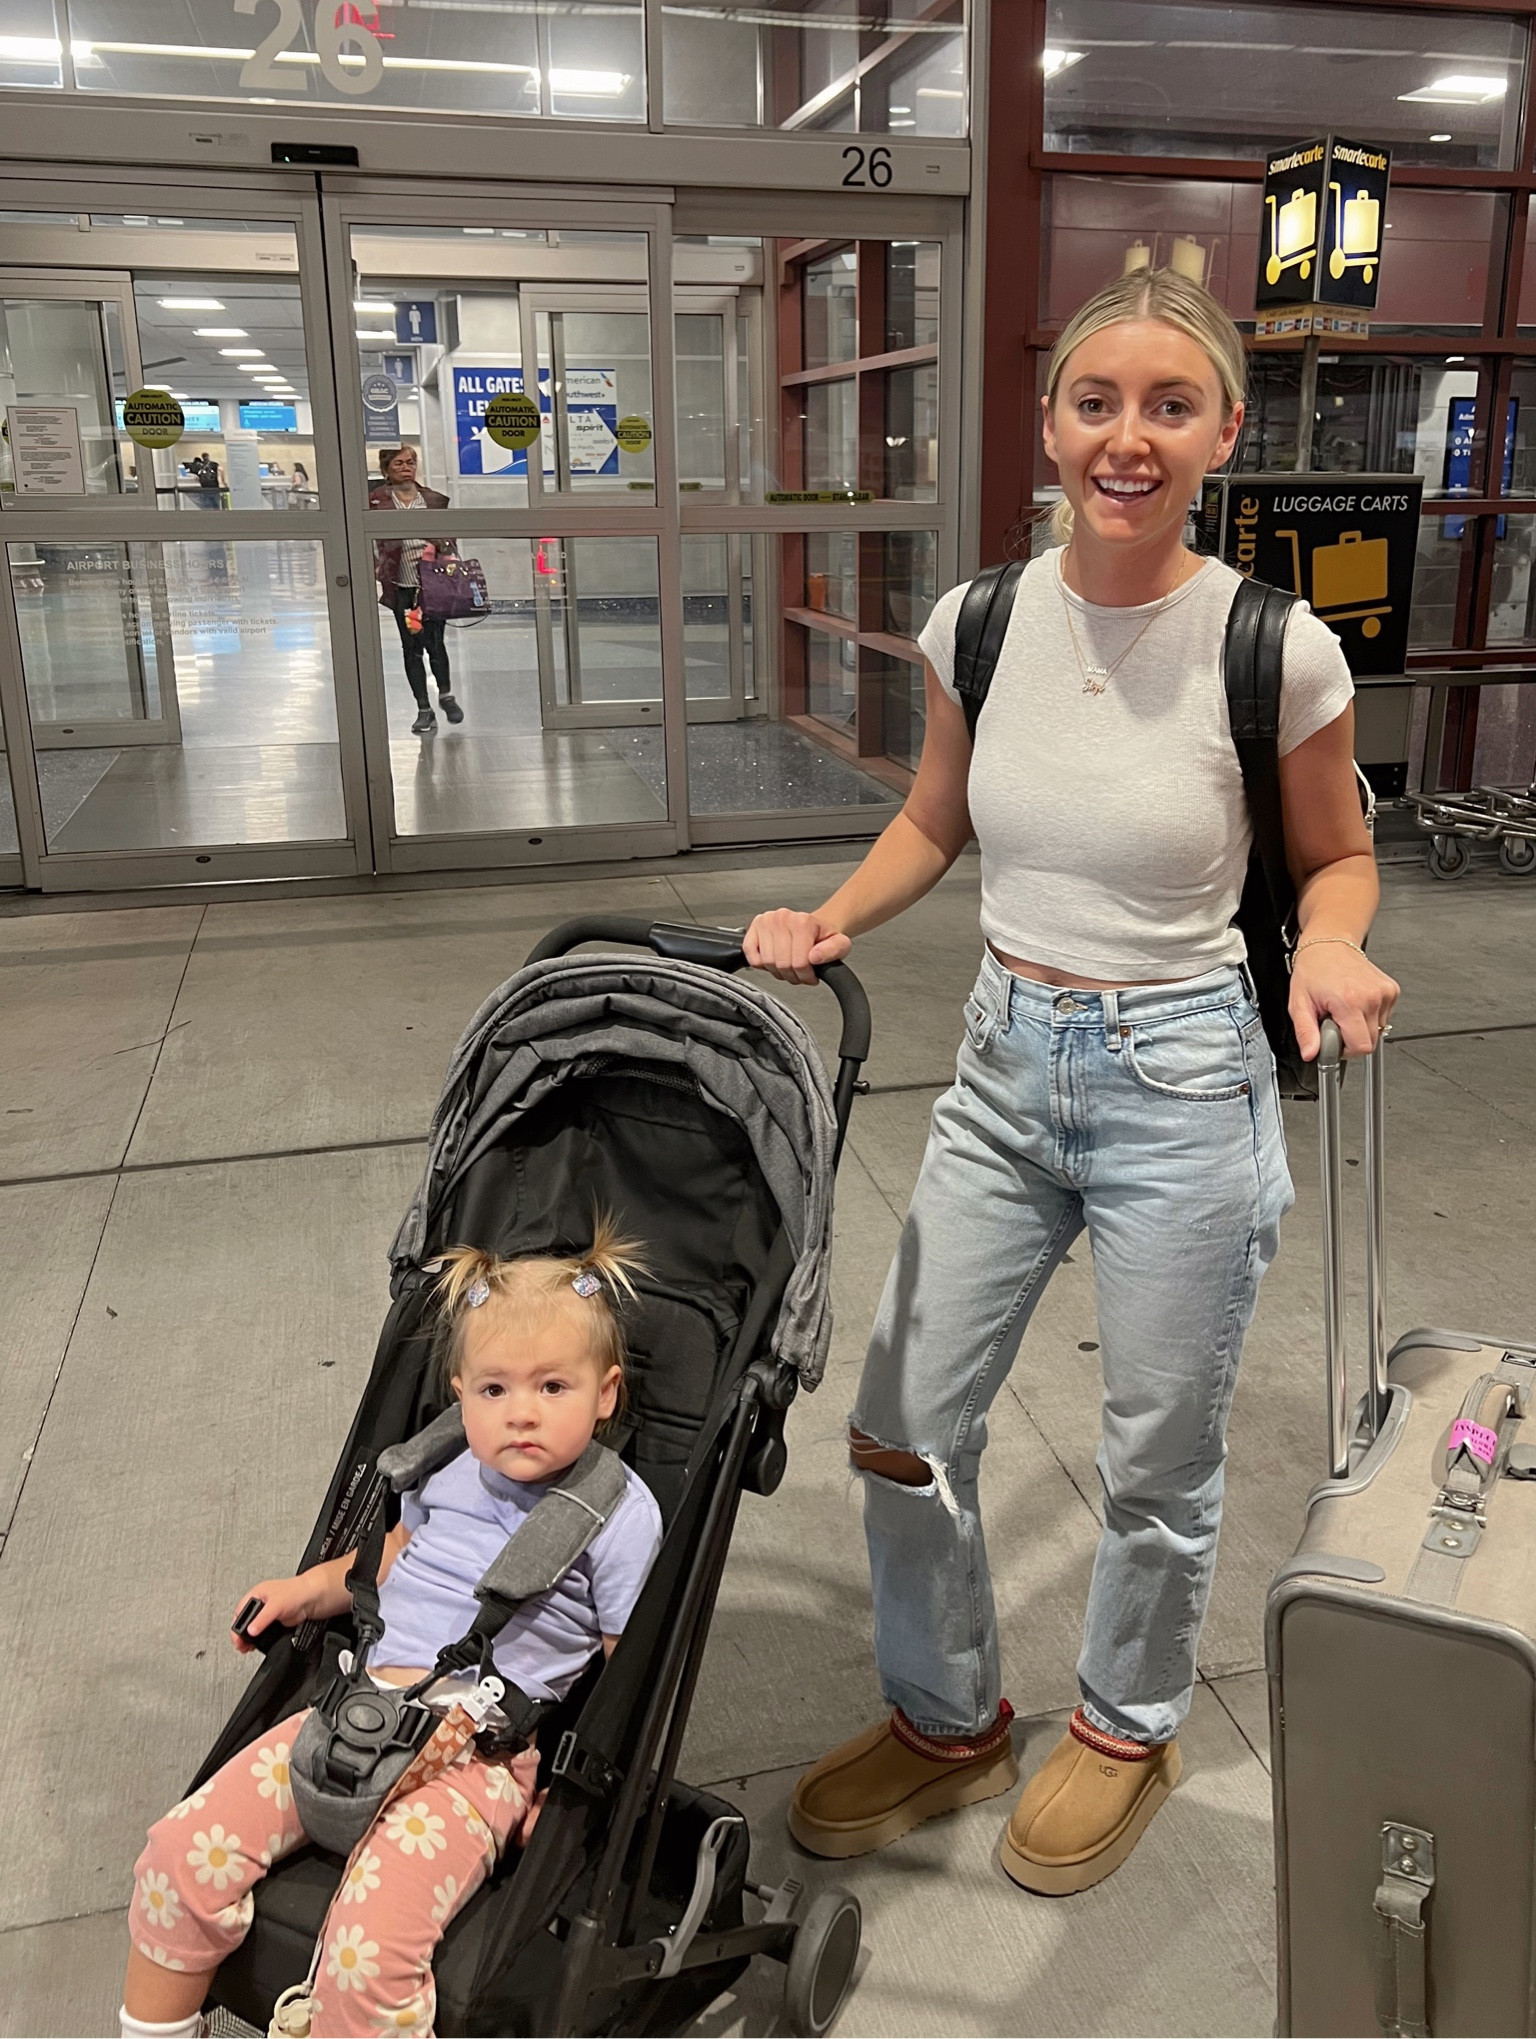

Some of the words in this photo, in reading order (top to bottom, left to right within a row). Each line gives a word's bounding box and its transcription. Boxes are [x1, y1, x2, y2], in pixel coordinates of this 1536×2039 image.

[233, 0, 385, 95] 26
[842, 146, 893, 187] 26
[458, 376, 485, 393] ALL
[566, 376, 601, 384] merican
[128, 403, 178, 411] AUTOMATIC
[490, 406, 535, 414] AUTOMATIC
[126, 413, 181, 424] CAUTION
[488, 416, 538, 427] CAUTION
[142, 428, 169, 436] DOOR
[617, 431, 650, 439] CAUTION
[770, 493, 802, 501] AUTOMATIC
[803, 493, 819, 501] DOOR
[1273, 496, 1357, 512] LUGGAGE
[1360, 495, 1409, 511] CARTS
[66, 560, 119, 570] AIRPORT
[122, 559, 181, 570] BUSINESS
[185, 559, 225, 569] HORS
[199, 627, 217, 635] with
[240, 626, 267, 636] airport
[331, 1510, 346, 1531] MISE
[340, 1498, 351, 1511] EN
[346, 1469, 362, 1497] GARDE
